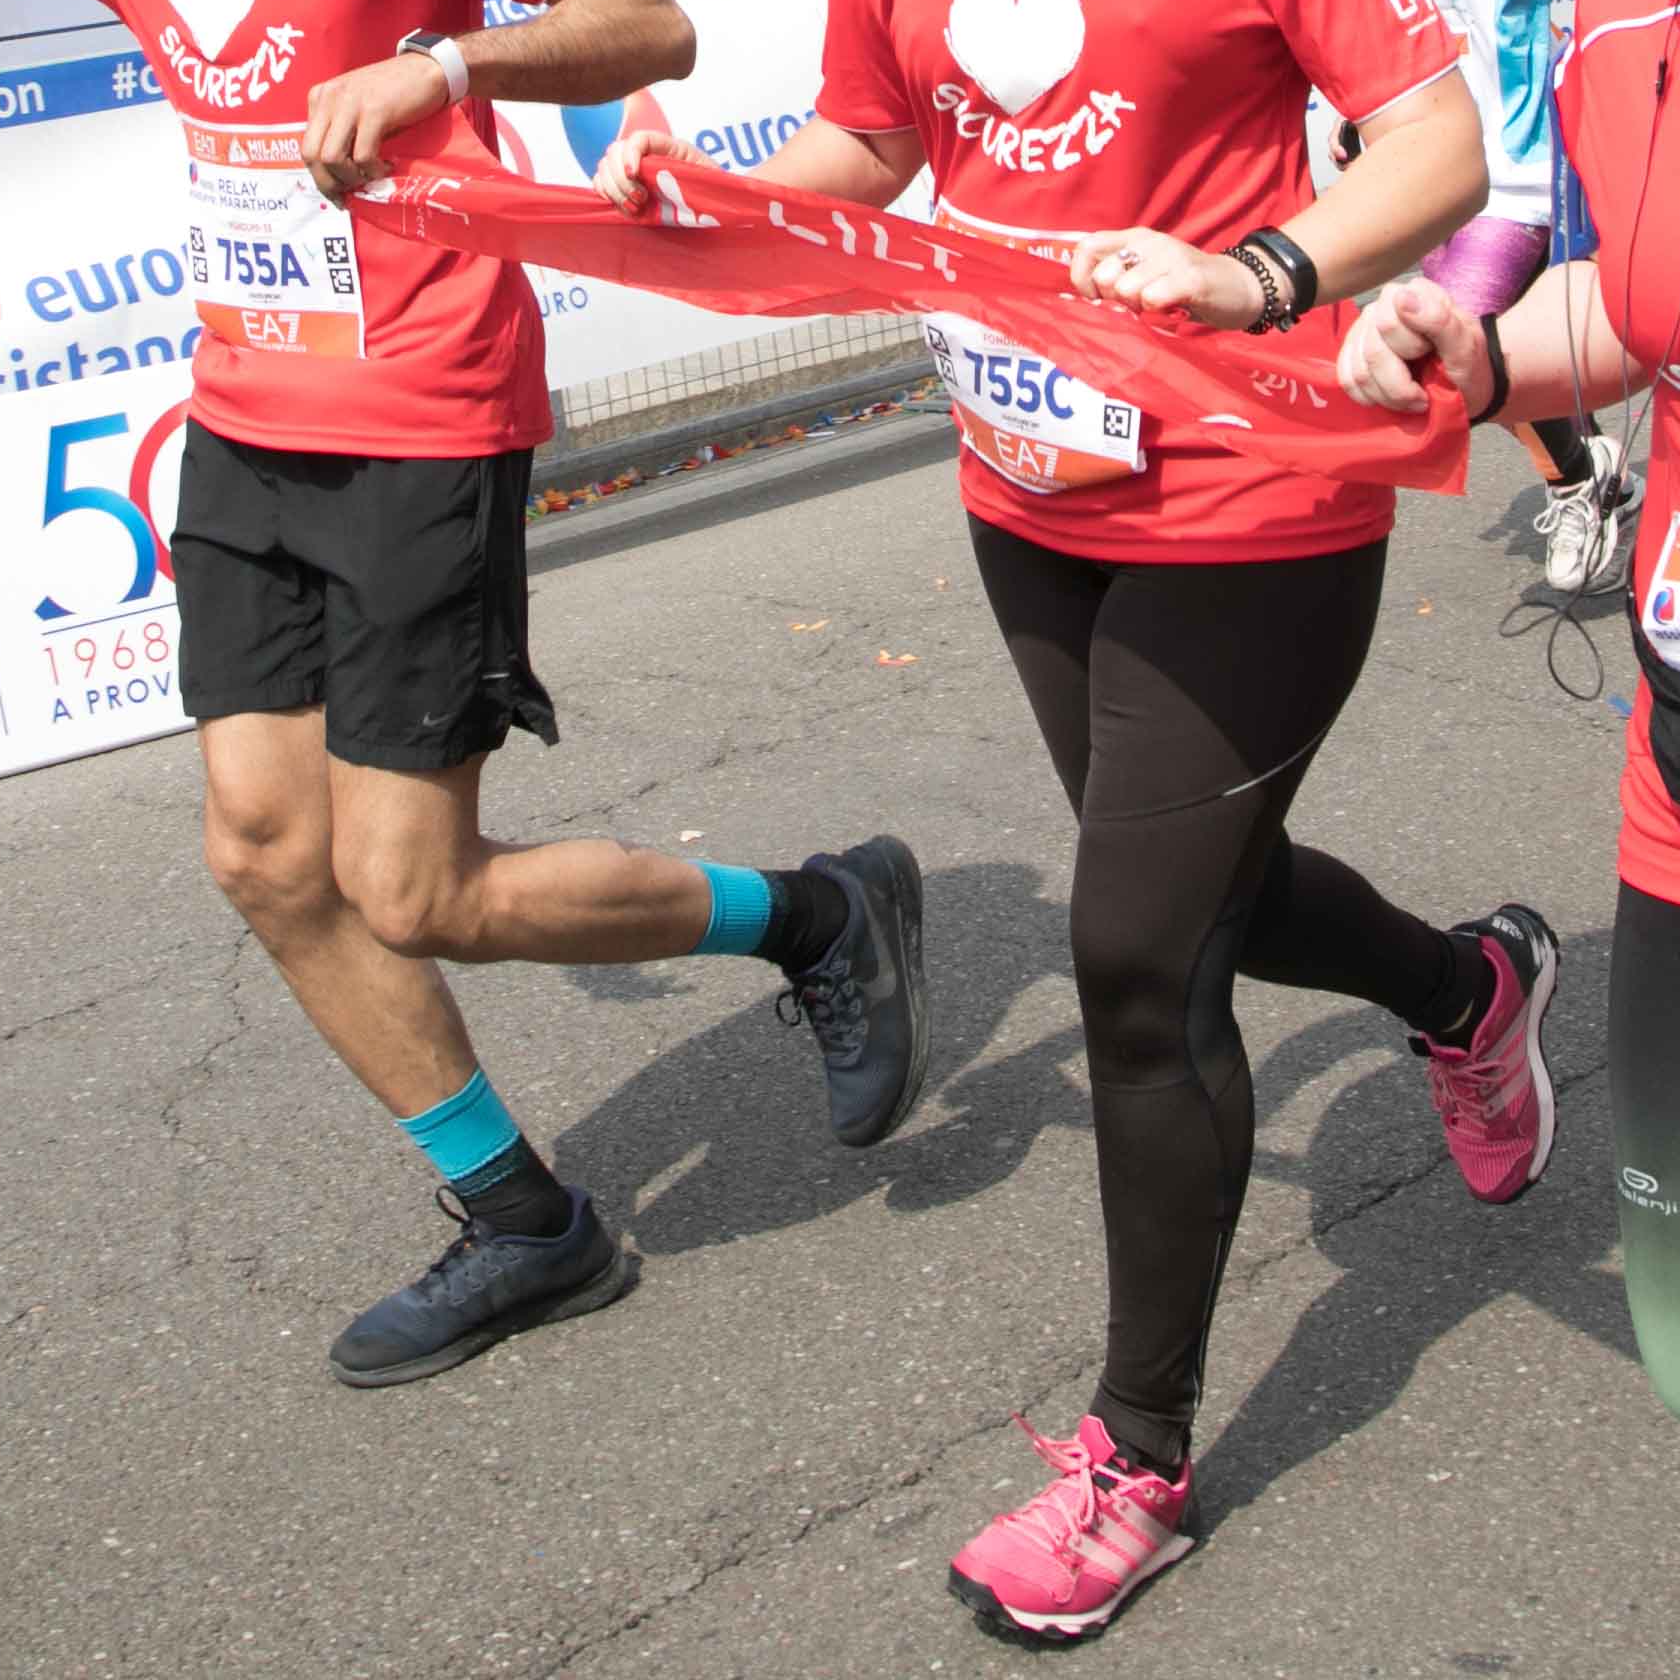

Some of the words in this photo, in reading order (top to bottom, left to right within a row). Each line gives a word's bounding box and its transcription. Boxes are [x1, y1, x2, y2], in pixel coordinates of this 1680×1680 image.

[158, 22, 305, 108] SICUREZZA
[247, 138, 300, 155] MILANO
[931, 80, 1136, 173] SICUREZZA
[217, 178, 258, 197] RELAY
[218, 196, 289, 211] MARATHON
[26, 240, 192, 323] euro
[216, 237, 311, 288] 755A
[240, 309, 302, 344] EA7
[963, 347, 1075, 420] 755C
[993, 429, 1059, 478] EA7
[43, 621, 170, 688] 1968
[50, 696, 73, 725] A
[86, 671, 178, 716] PROV
